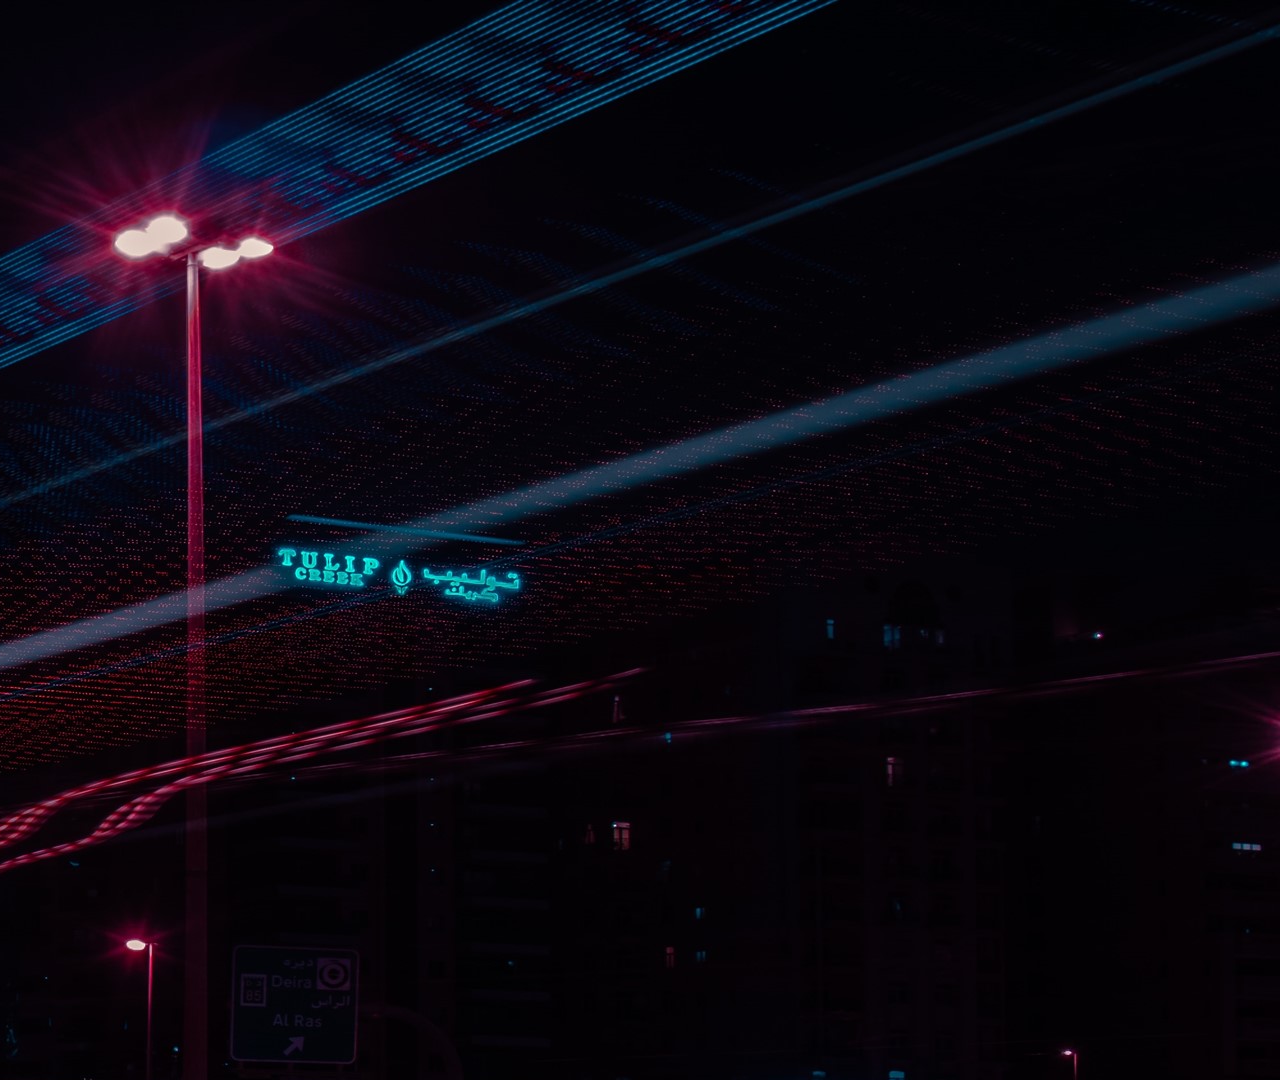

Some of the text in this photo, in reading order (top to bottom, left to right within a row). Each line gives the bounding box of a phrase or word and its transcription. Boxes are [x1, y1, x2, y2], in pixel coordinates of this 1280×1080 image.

[279, 549, 380, 575] TULIP
[295, 567, 364, 586] CREEK
[423, 568, 521, 591] توليب
[271, 975, 313, 989] Deira
[272, 1013, 323, 1028] Al Ras
